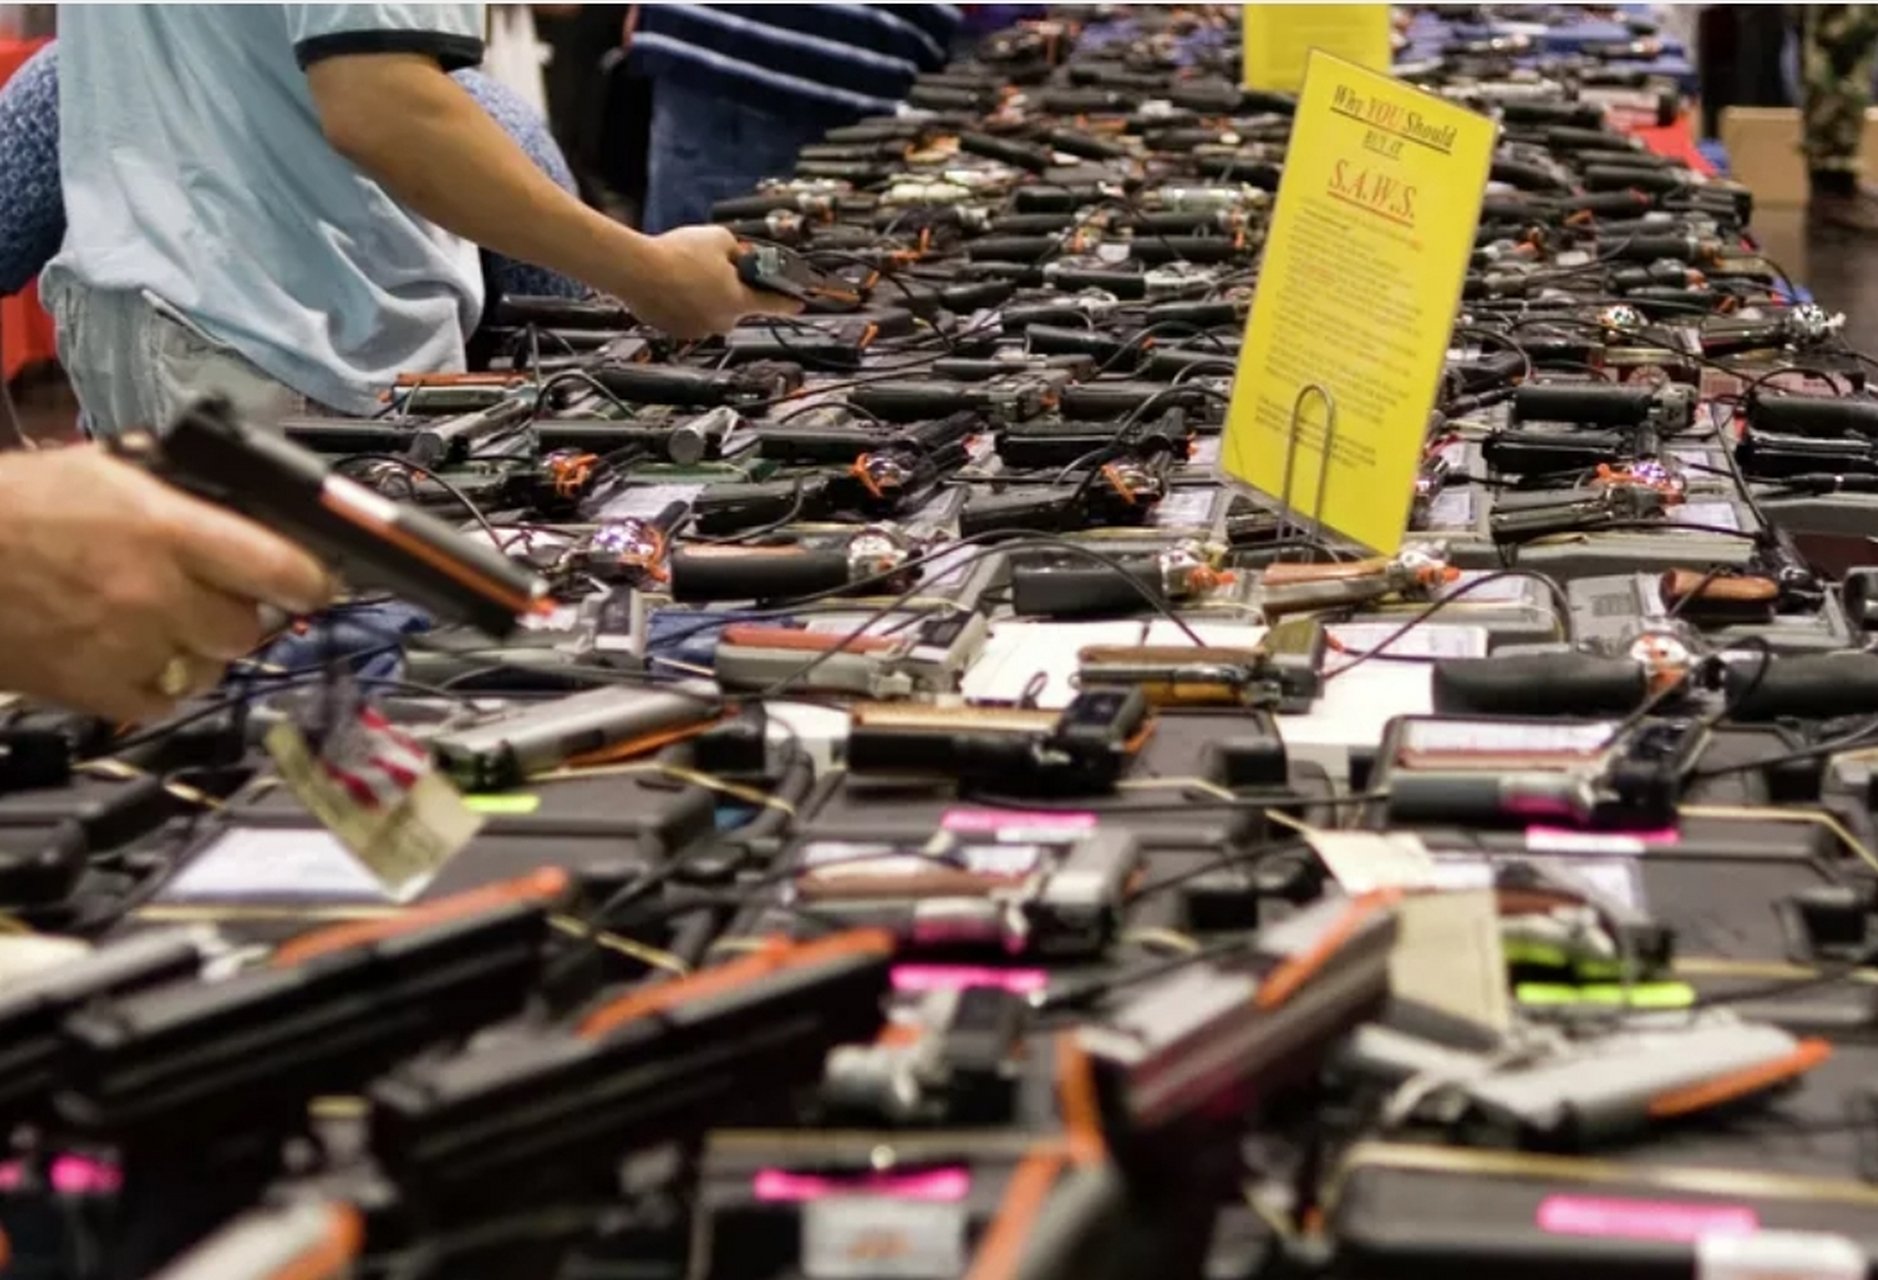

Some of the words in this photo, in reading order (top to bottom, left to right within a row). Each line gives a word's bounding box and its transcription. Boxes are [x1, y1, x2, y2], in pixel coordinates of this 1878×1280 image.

[1332, 84, 1363, 117] Why
[1366, 95, 1404, 130] YOU
[1403, 110, 1458, 149] Should
[1328, 158, 1417, 219] S.A.W.S.
